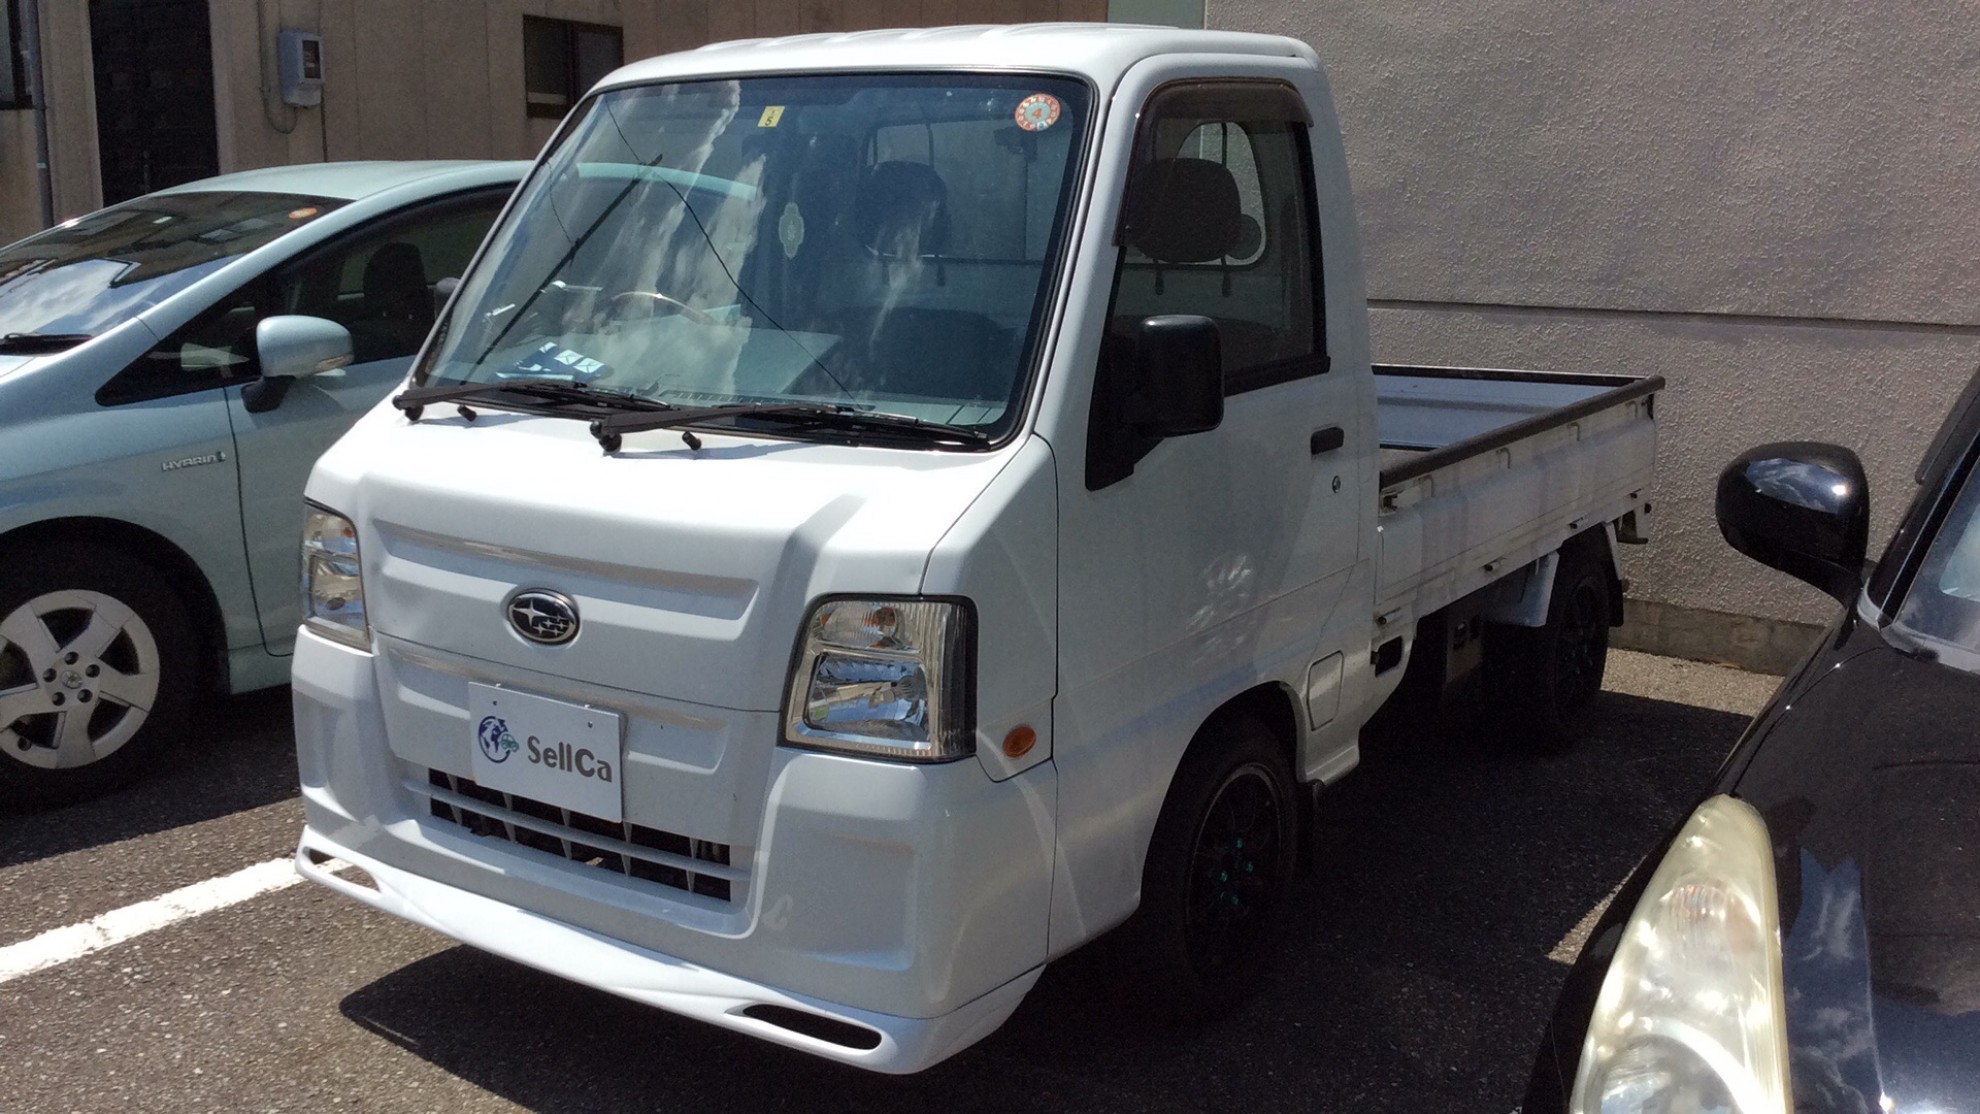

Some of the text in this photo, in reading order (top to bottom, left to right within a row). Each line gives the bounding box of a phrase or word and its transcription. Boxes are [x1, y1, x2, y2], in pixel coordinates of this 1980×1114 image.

[764, 116, 774, 126] 5
[161, 454, 218, 472] HYBRID
[527, 735, 612, 783] SellCa
